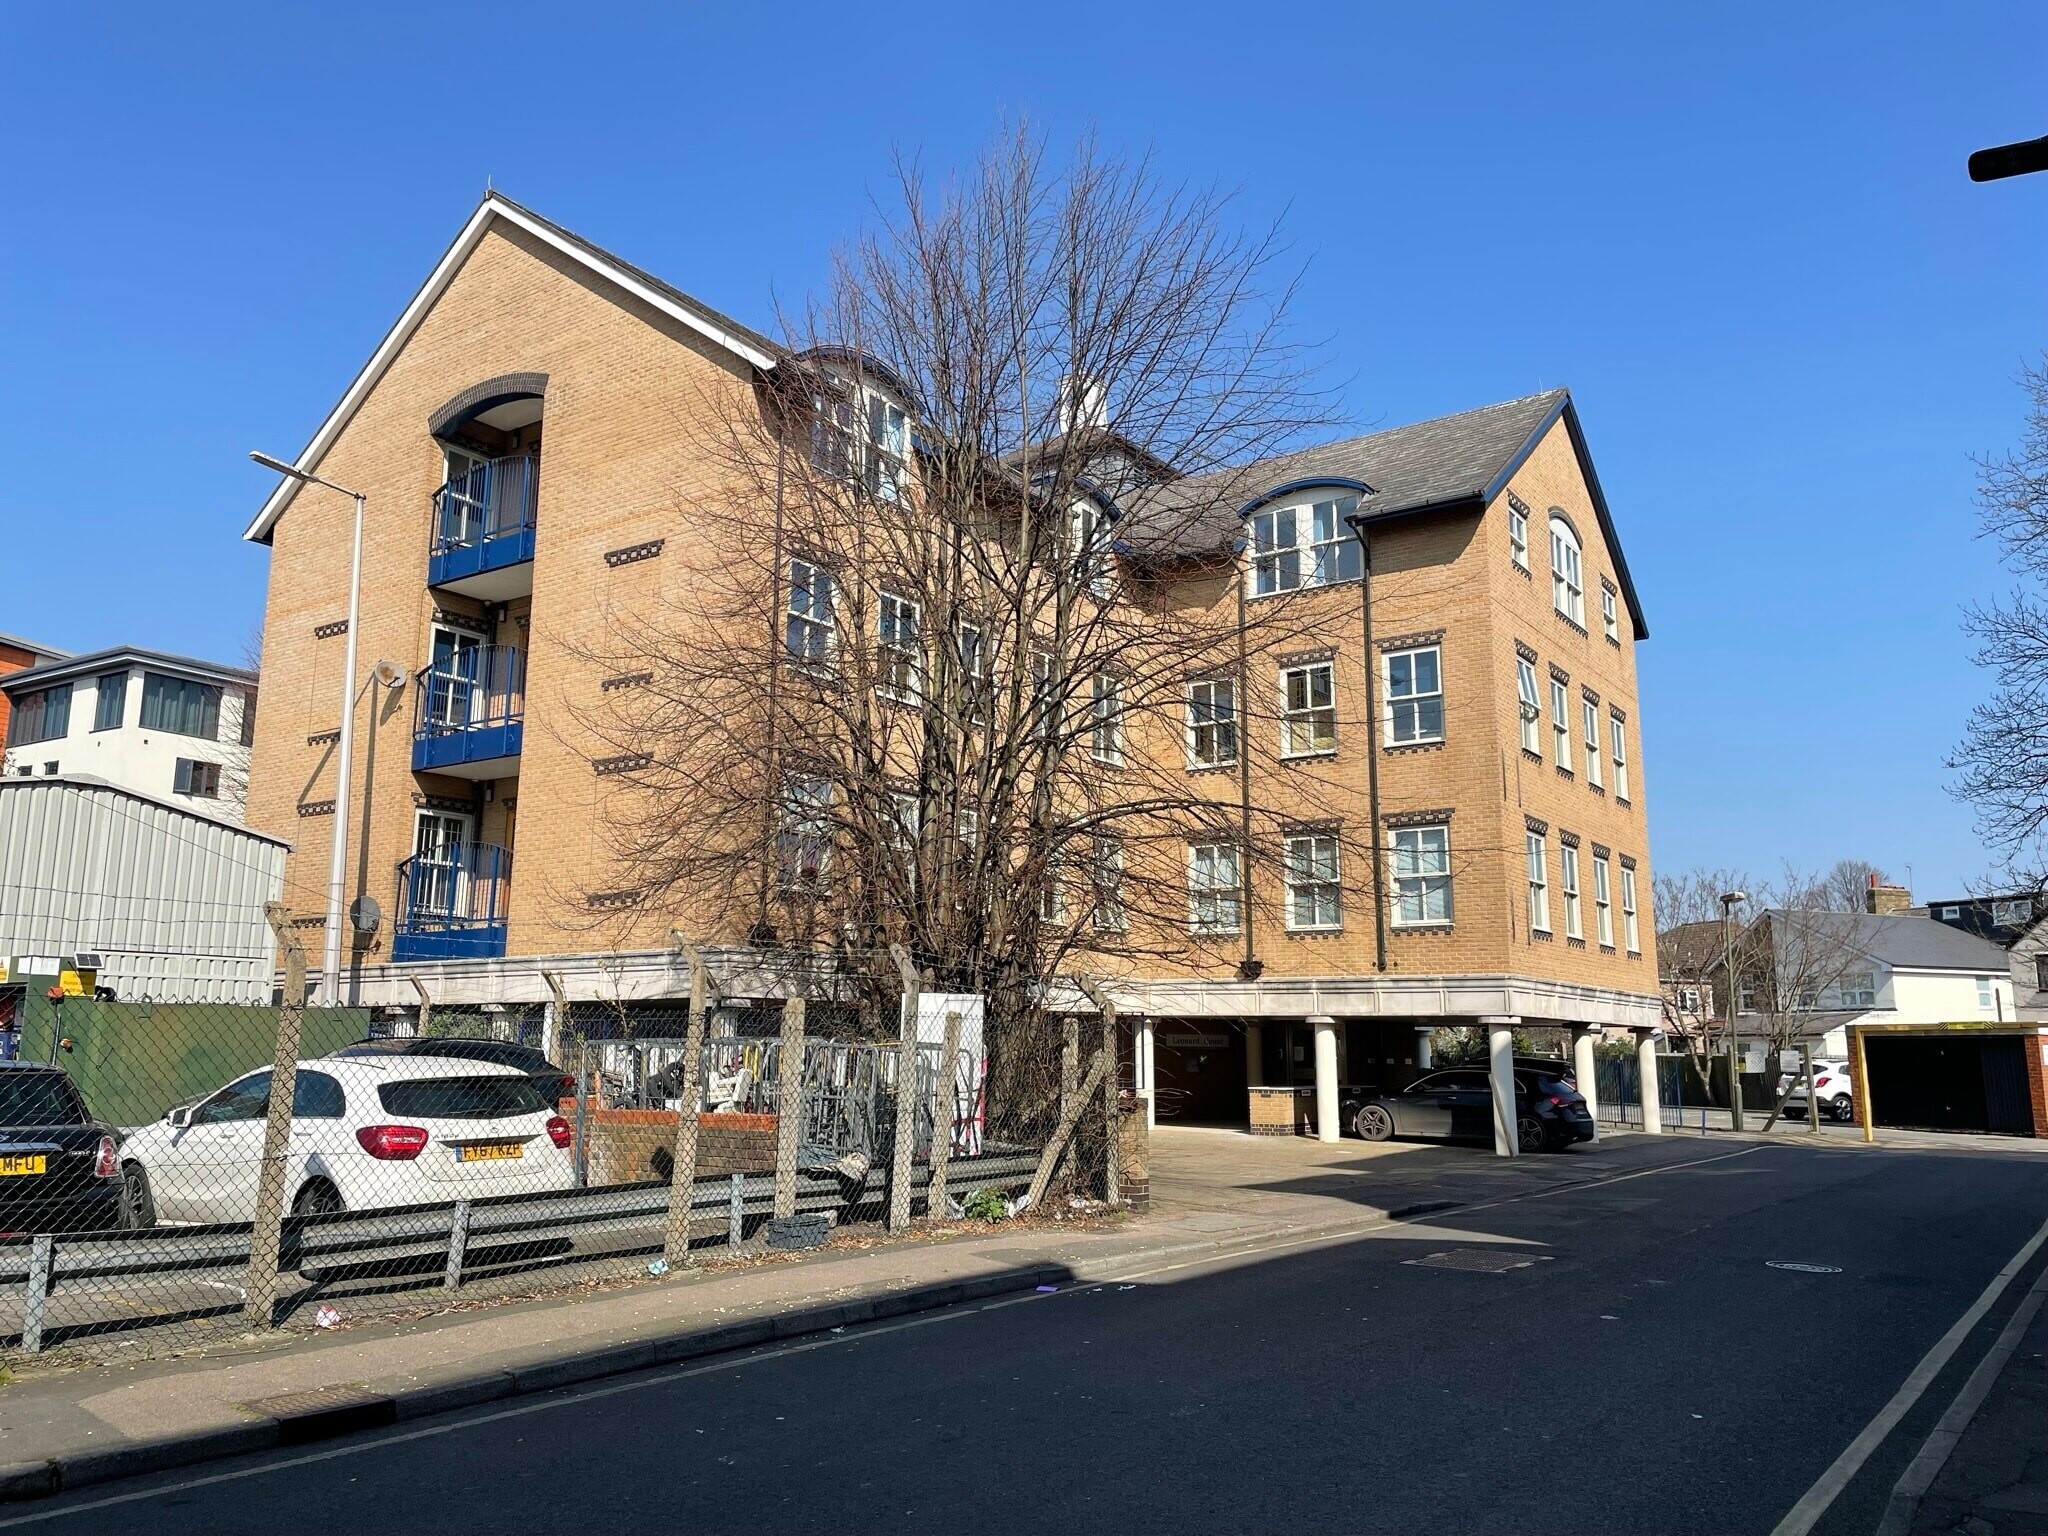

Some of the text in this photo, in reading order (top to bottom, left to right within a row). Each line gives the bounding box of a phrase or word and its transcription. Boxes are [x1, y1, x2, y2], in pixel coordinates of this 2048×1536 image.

[1172, 1036, 1200, 1045] Leonard
[463, 1142, 521, 1159] FY67 KZP
[3, 1155, 35, 1172] MFU
